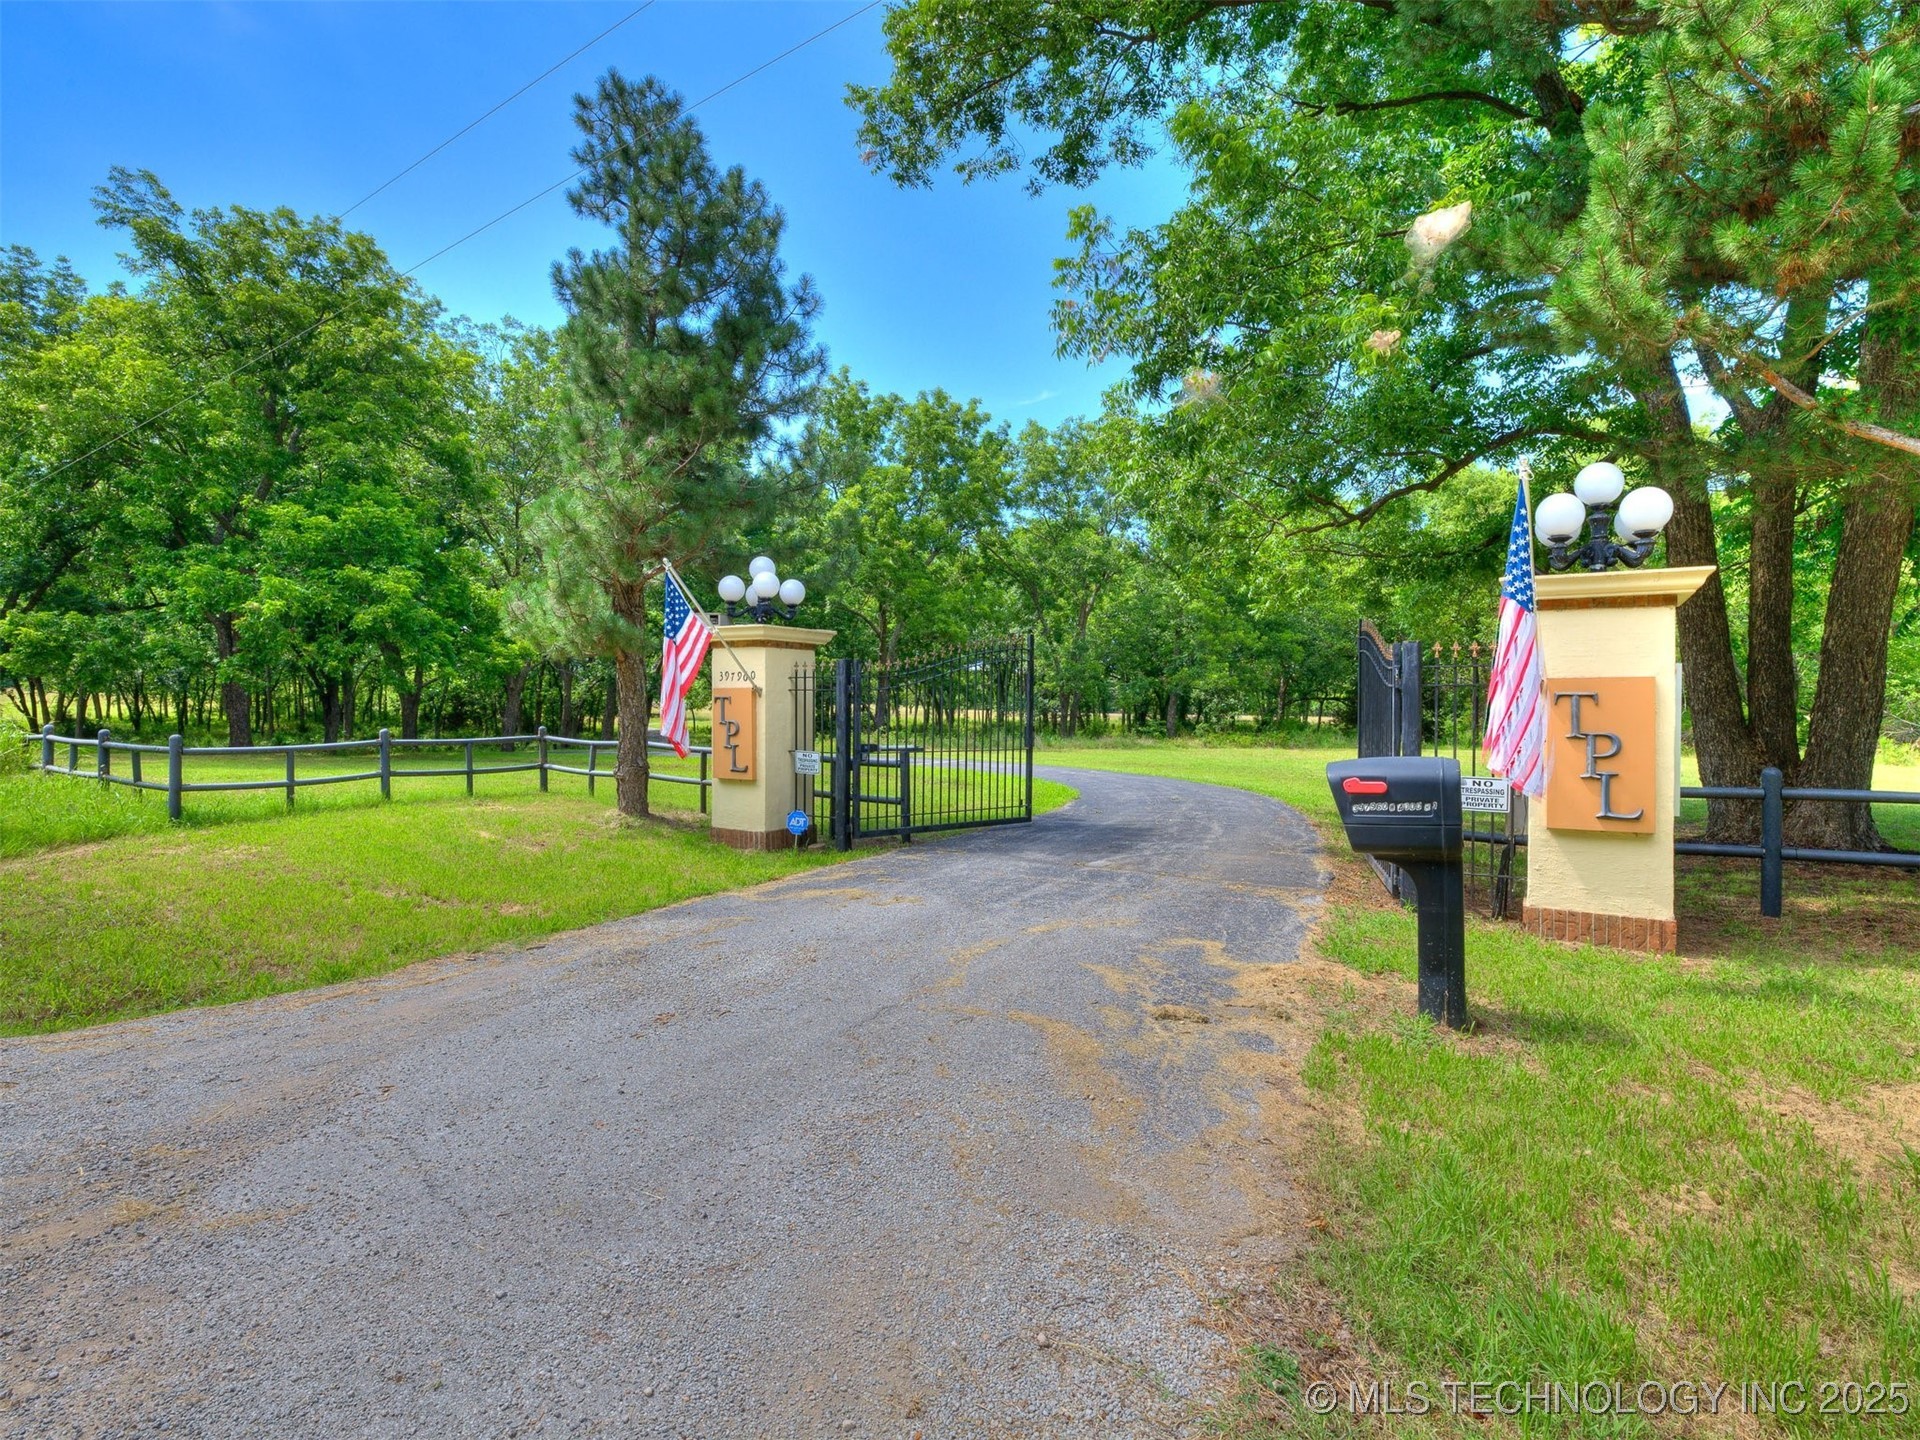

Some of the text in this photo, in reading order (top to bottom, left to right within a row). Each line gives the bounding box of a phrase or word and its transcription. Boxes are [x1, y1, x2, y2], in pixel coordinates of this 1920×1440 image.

[1472, 780, 1494, 788] NO
[1461, 786, 1505, 796] TRESPASSING
[1465, 796, 1500, 804] PRIVATE
[789, 817, 806, 827] ADT
